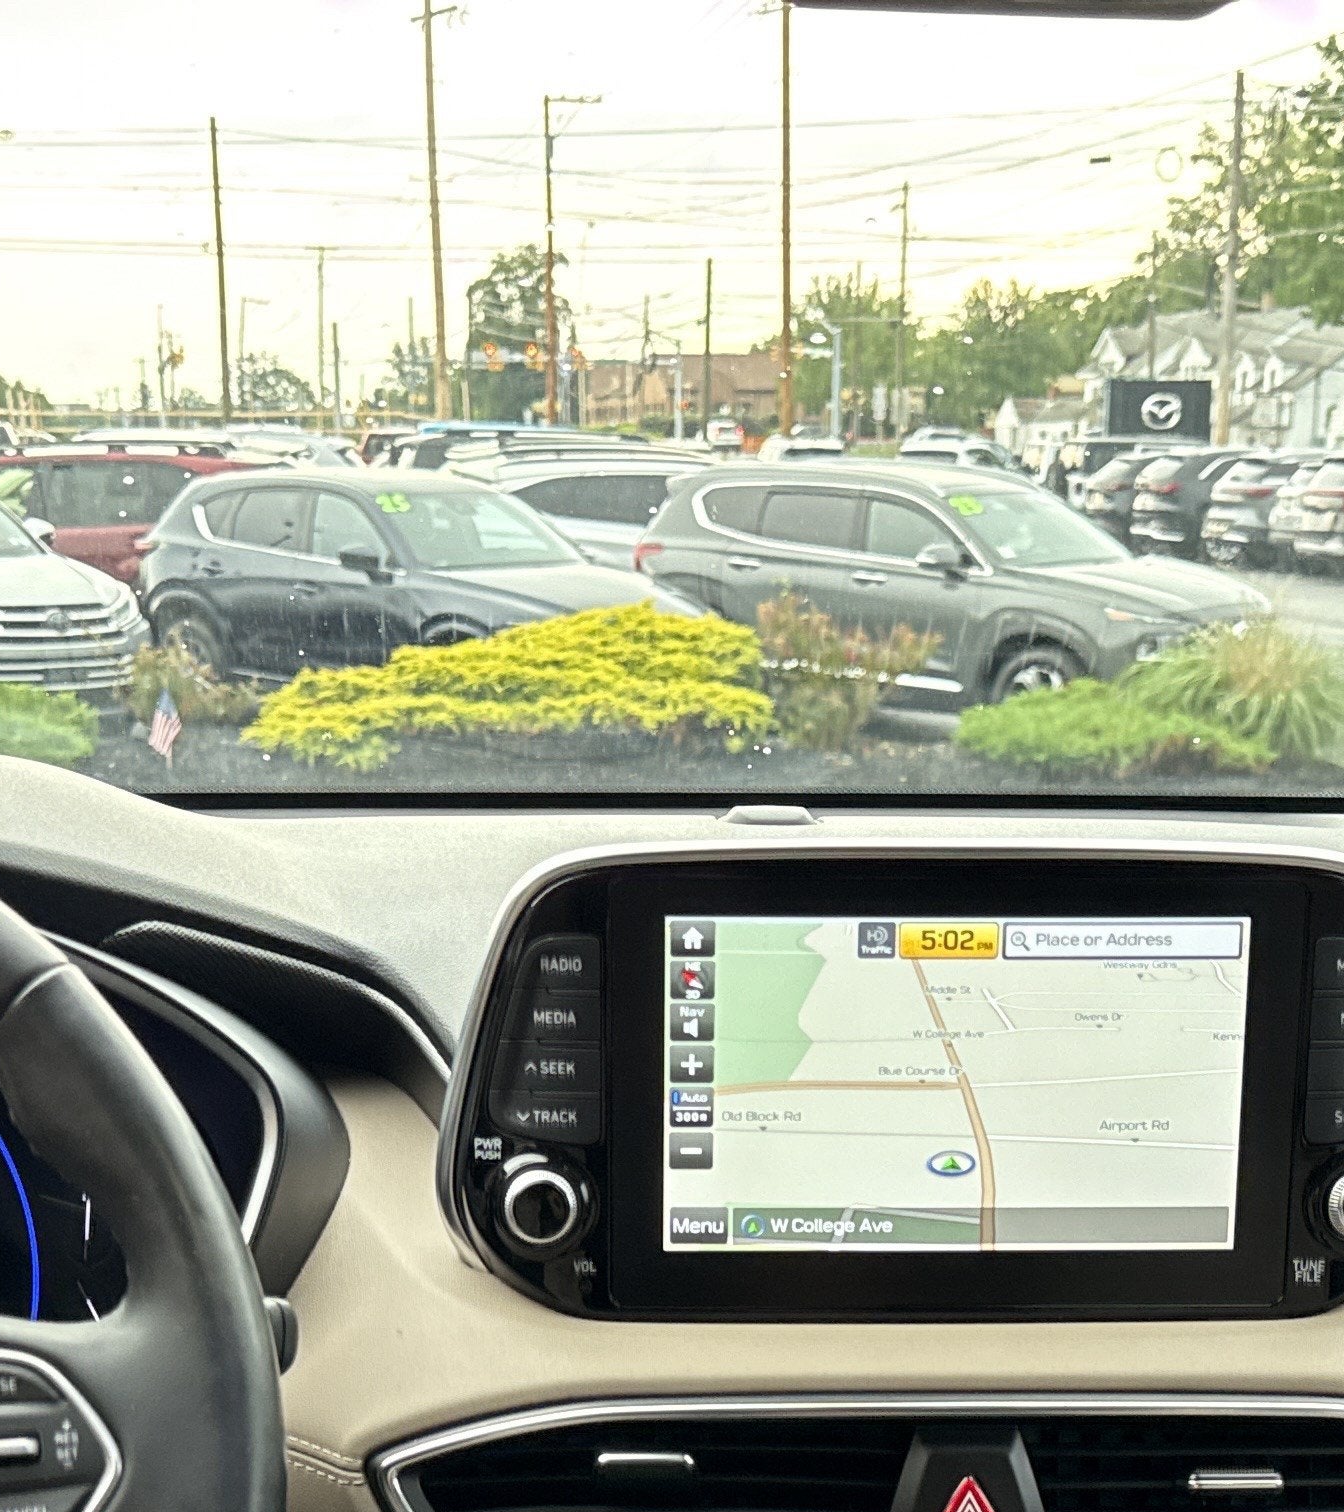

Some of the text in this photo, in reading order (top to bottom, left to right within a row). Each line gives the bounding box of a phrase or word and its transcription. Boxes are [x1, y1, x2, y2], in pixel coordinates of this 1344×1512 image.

[921, 930, 974, 951] 5:02
[1035, 933, 1173, 947] Place or Address
[540, 956, 583, 973] RADIO
[533, 1009, 577, 1027] MEDIA
[679, 1006, 706, 1018] Nav
[1074, 1012, 1109, 1022] Owens
[539, 1062, 576, 1076] SEEK
[878, 1066, 903, 1076] Blue
[905, 1066, 946, 1076] Course
[679, 1092, 708, 1104] Auto
[532, 1110, 577, 1124] TRACK
[721, 1110, 802, 1122] Old Block Rd
[1099, 1119, 1170, 1133] Airport Rd
[473, 1137, 503, 1150] PWR
[474, 1150, 502, 1161] PUSH
[672, 1216, 725, 1234] Menu
[770, 1217, 894, 1239] W College Ave
[573, 1259, 597, 1275] VOL
